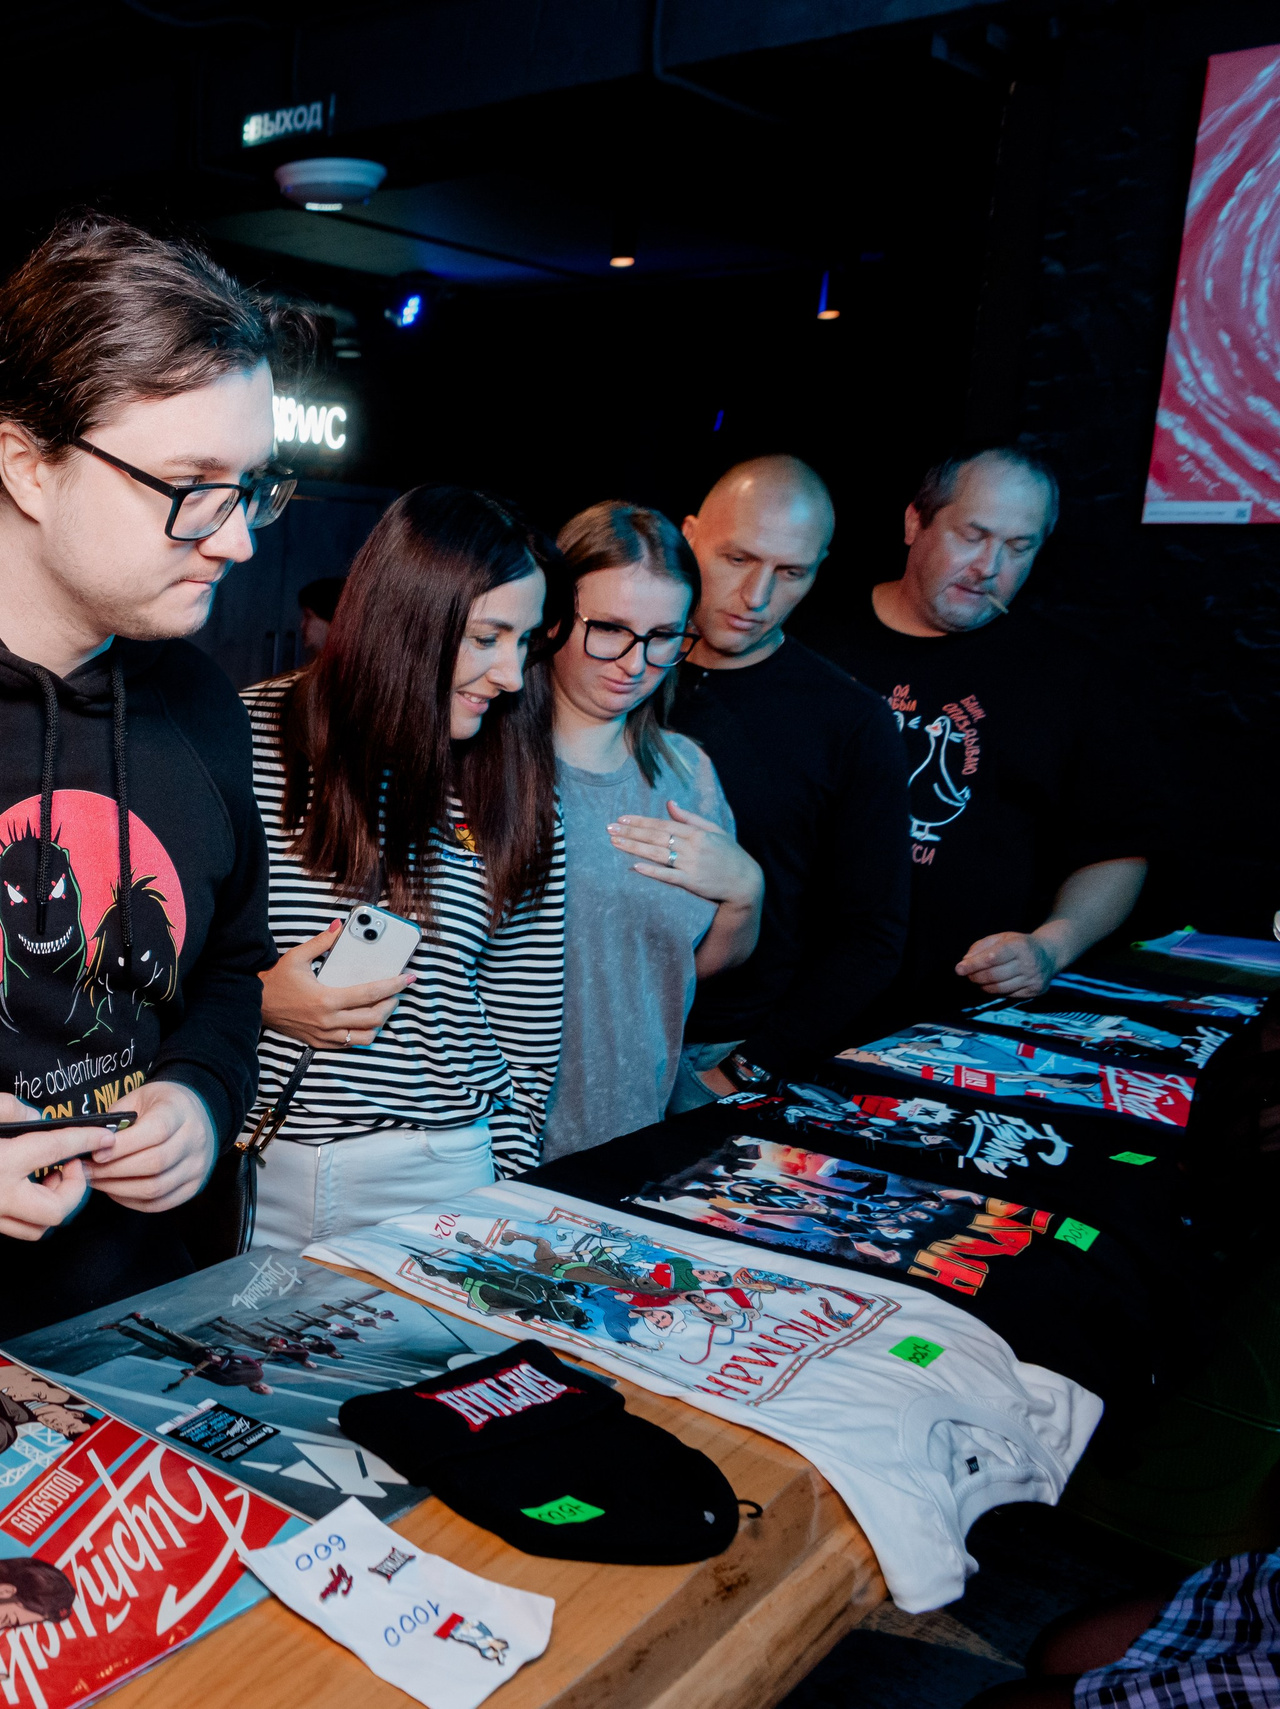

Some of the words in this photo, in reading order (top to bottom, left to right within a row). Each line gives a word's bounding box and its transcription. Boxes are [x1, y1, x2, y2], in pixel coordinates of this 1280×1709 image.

[250, 100, 323, 140] ВЫХОД
[911, 843, 937, 866] СИ
[13, 1071, 43, 1100] the
[45, 1052, 117, 1095] adventures
[120, 1038, 136, 1066] of
[434, 1361, 569, 1432] БИРТМАН
[7, 1467, 85, 1535] ПОДБУХНУ
[294, 1533, 347, 1572] 600
[383, 1599, 441, 1648] 1000
